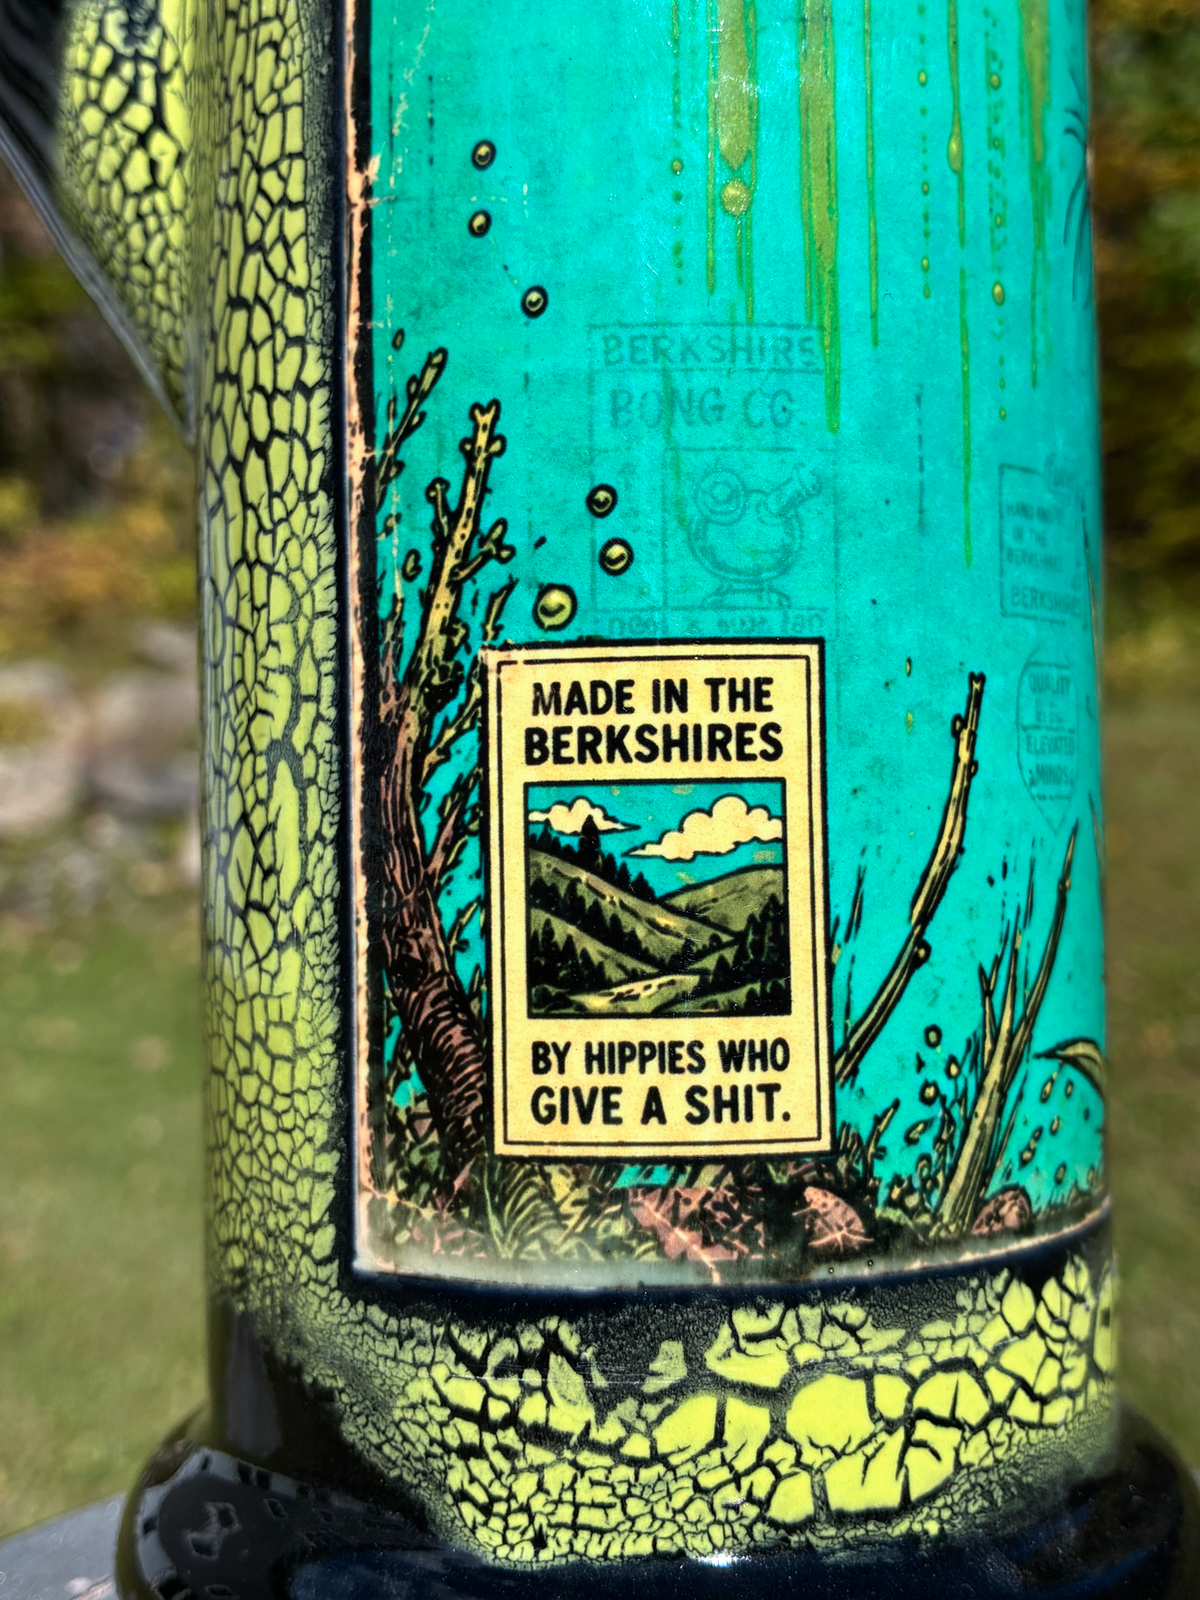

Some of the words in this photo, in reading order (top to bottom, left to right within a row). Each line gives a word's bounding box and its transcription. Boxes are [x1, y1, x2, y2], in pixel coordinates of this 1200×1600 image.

[602, 332, 817, 368] BERKSHIRE
[610, 385, 727, 429] BONG
[533, 679, 635, 716] MADE
[653, 679, 688, 713] IN
[704, 677, 773, 712] THE
[525, 722, 783, 765] BERKSHIRES
[532, 1041, 571, 1074] BY
[585, 1040, 705, 1074] HIPPIES
[718, 1038, 789, 1073] WHO
[531, 1086, 622, 1125] GIVE
[641, 1086, 666, 1124] A
[686, 1083, 790, 1125] SHIT.
